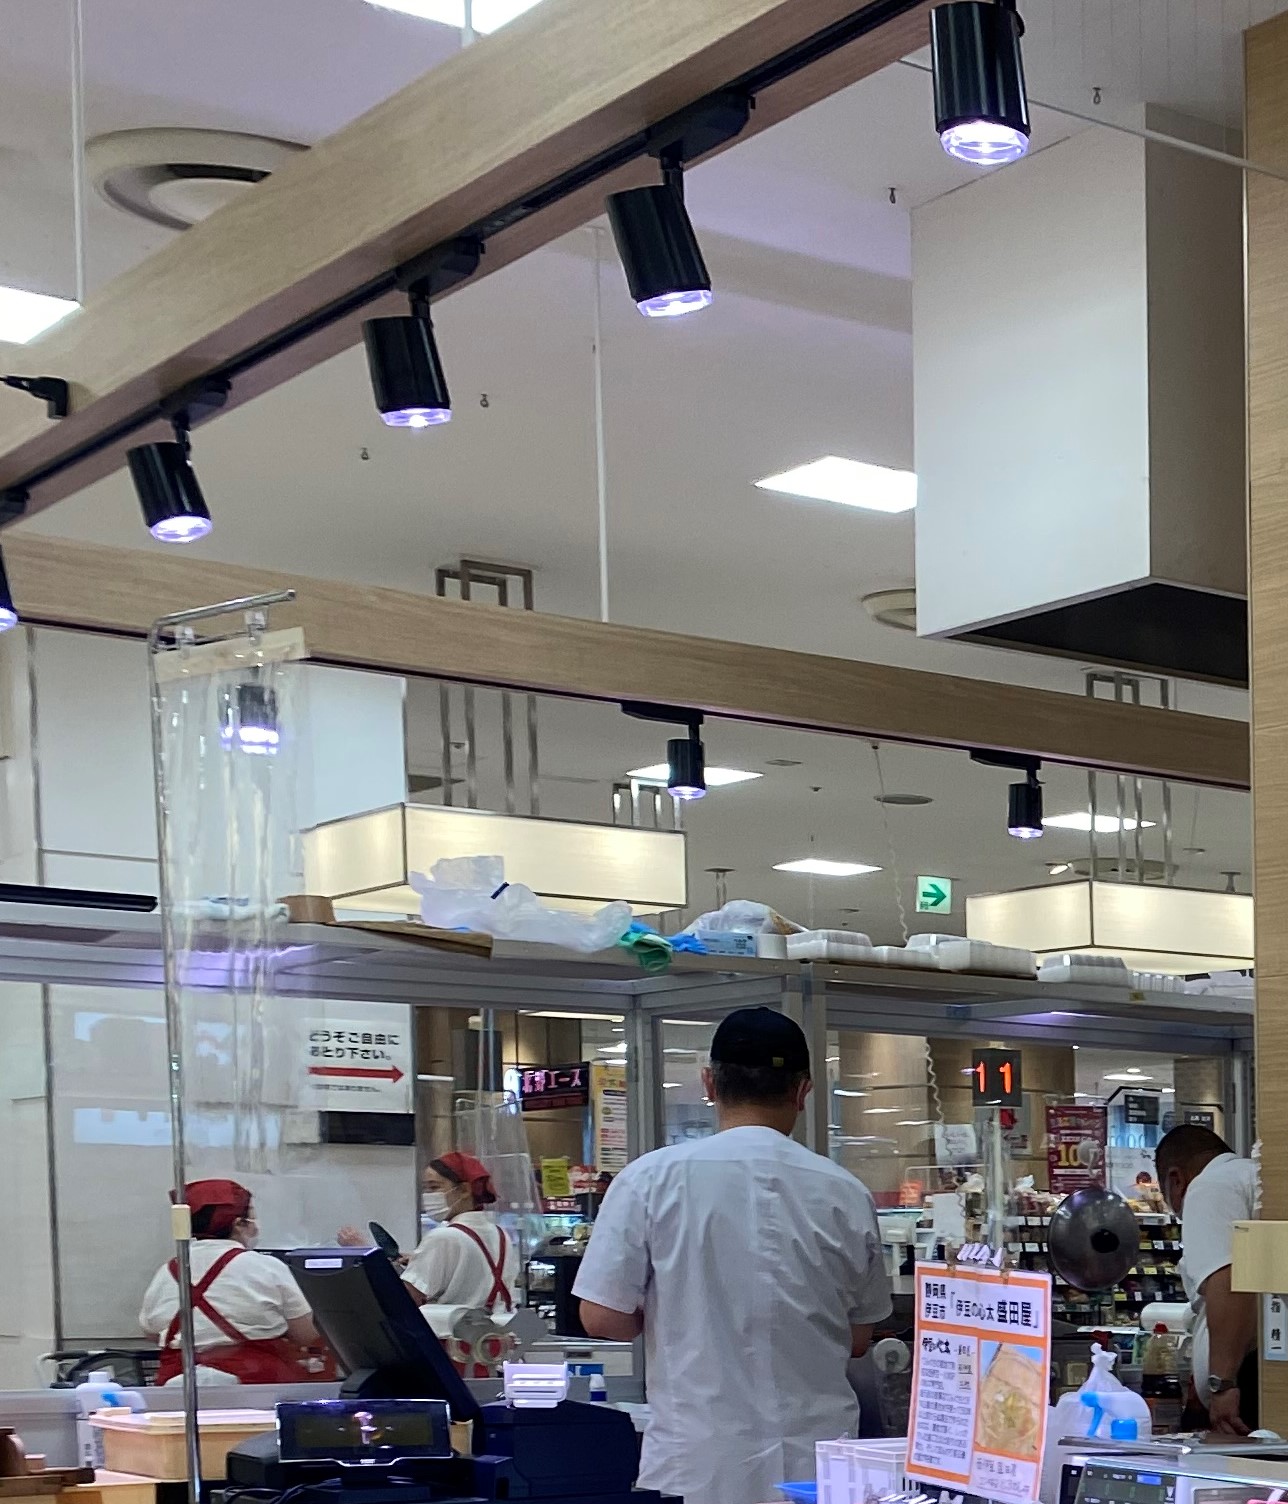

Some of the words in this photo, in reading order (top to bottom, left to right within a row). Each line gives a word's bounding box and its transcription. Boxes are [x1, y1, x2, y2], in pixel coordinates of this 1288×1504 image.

[308, 1030, 400, 1046] どうぞご自由に
[309, 1046, 392, 1060] おとり下さい。
